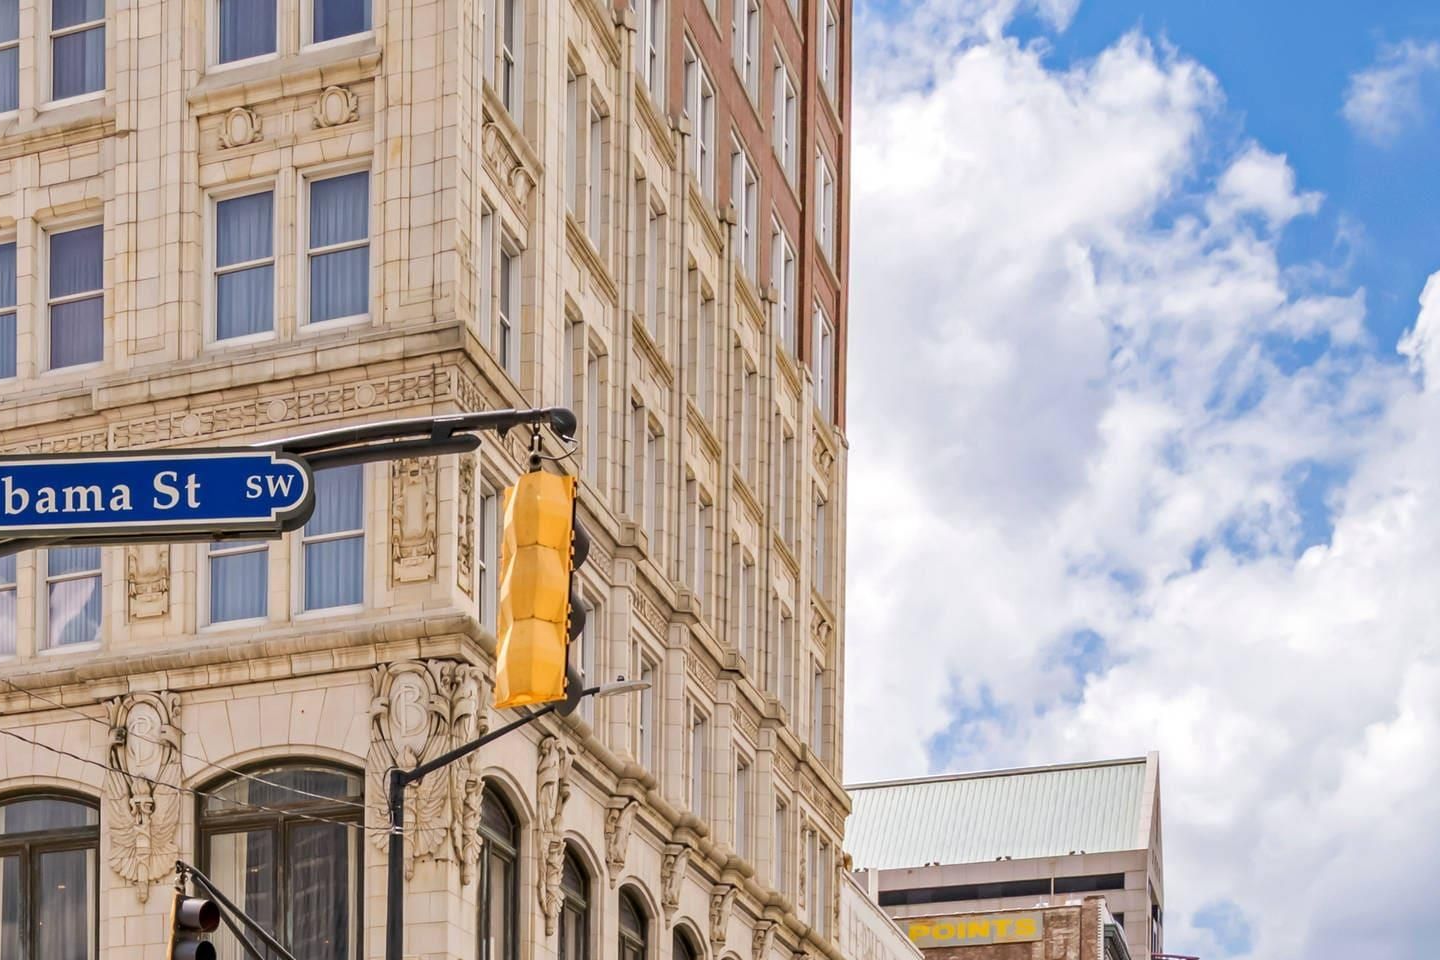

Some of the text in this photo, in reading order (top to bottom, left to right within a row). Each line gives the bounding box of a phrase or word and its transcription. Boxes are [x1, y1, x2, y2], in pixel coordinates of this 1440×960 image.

[152, 471, 201, 510] St
[246, 474, 294, 498] SW
[908, 918, 1037, 942] POINTS
